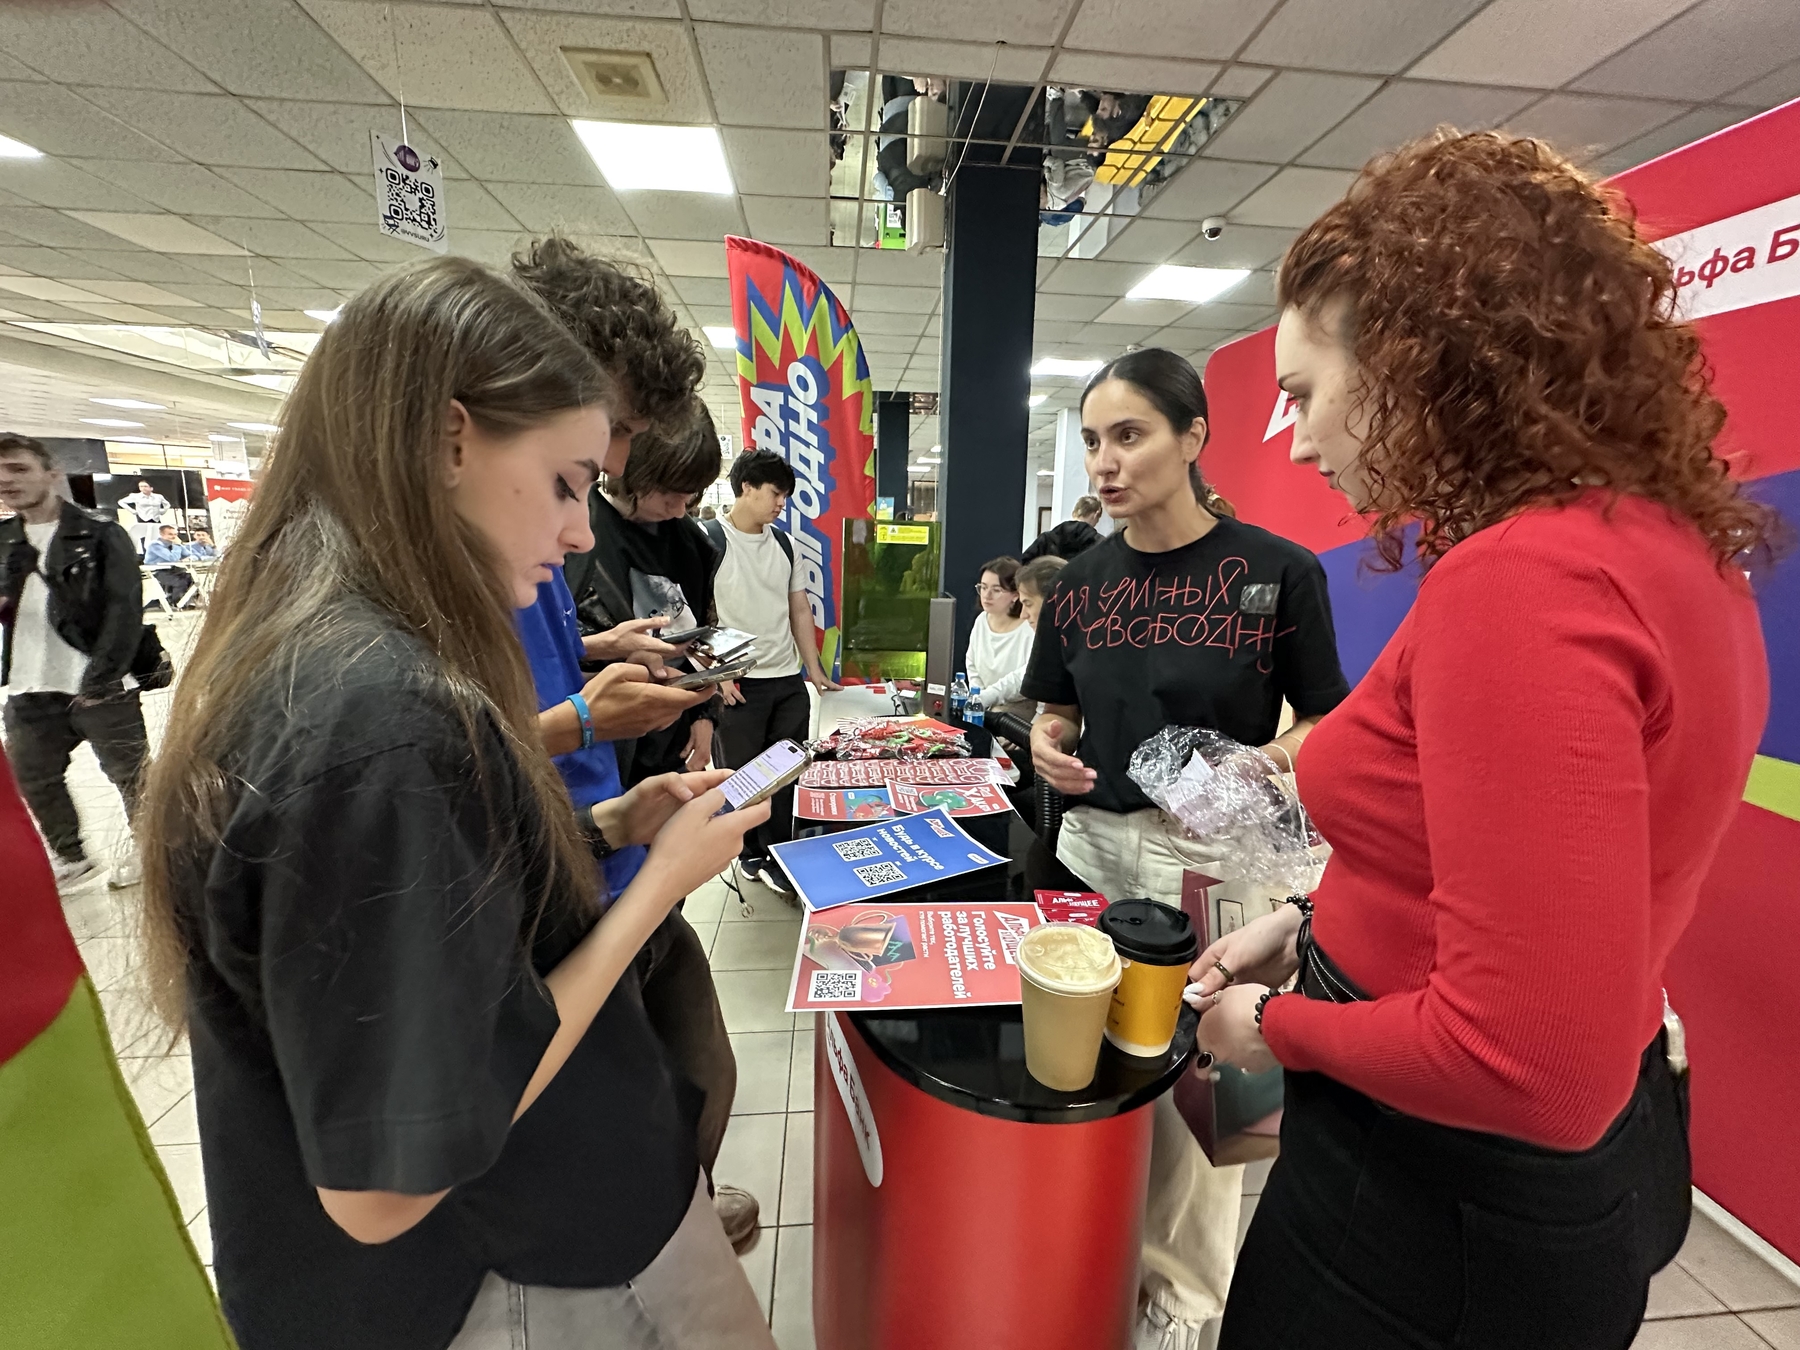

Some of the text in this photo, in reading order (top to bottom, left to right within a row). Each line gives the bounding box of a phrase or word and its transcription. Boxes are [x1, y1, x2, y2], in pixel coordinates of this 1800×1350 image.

[1098, 557, 1248, 632] УМНЫХ
[1077, 610, 1297, 661] СВОБОДН
[877, 828, 919, 863] новостей
[891, 824, 914, 846] Будь
[937, 911, 972, 999] работодателей
[956, 911, 979, 971] за лучших
[971, 911, 997, 970] Голосуйте
[1000, 916, 1026, 939] АЛЬФ
